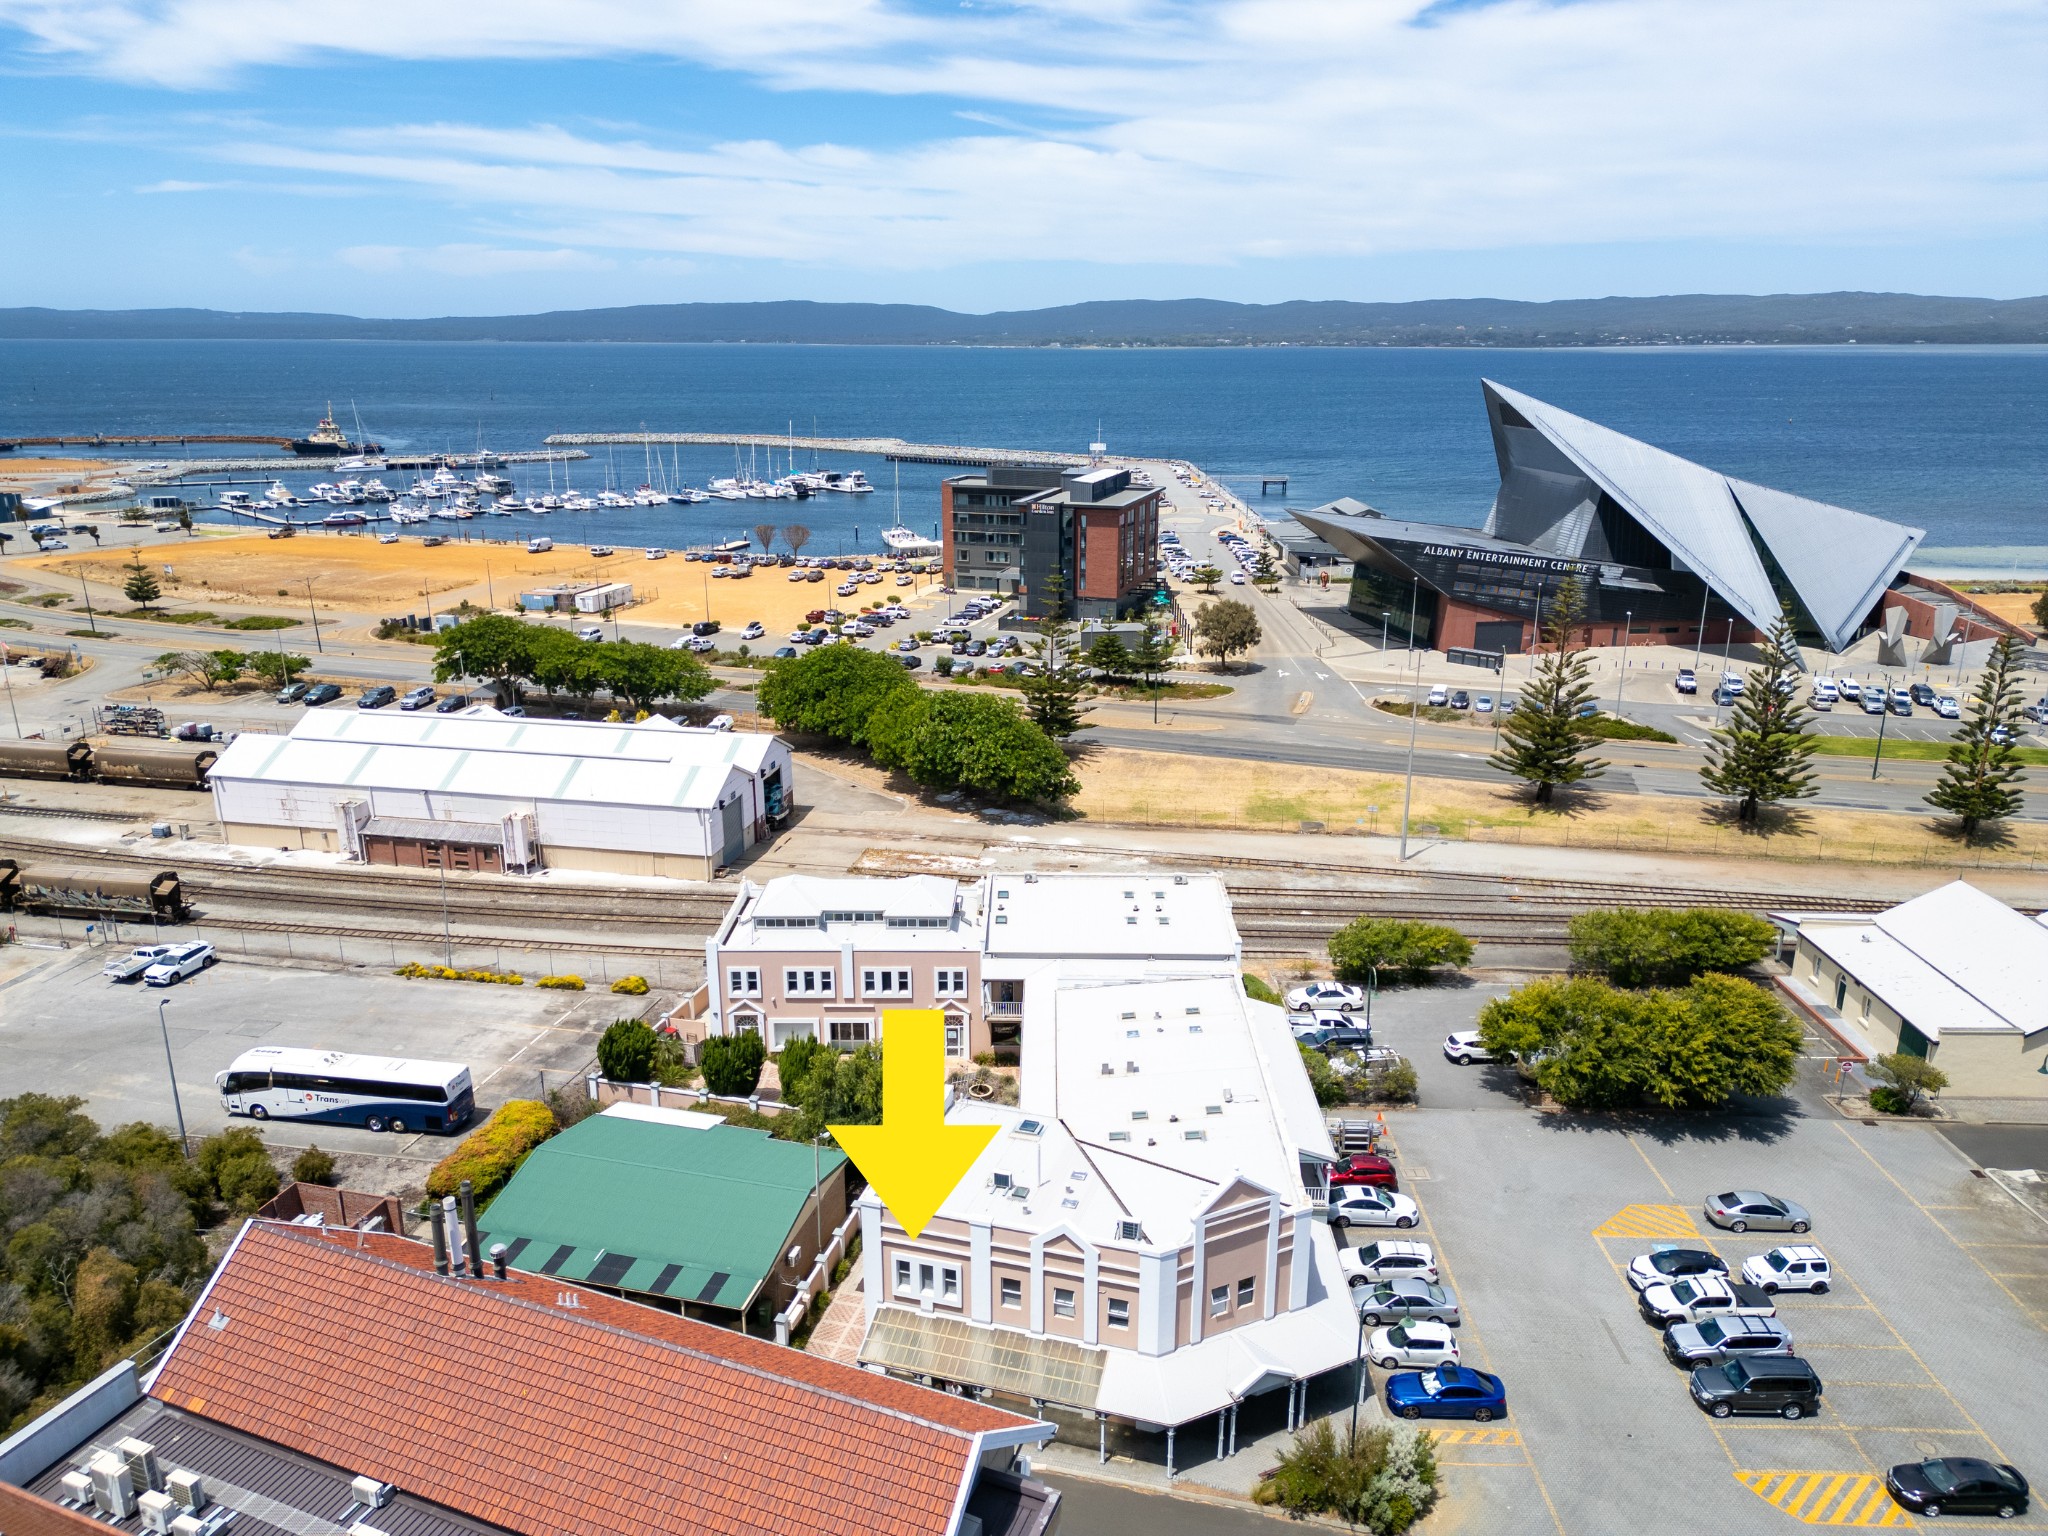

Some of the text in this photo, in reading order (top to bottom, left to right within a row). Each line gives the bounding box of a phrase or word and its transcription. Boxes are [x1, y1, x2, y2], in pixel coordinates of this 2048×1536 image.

[1424, 546, 1588, 573] ALBANY ENTERTAINMENT CENTRE
